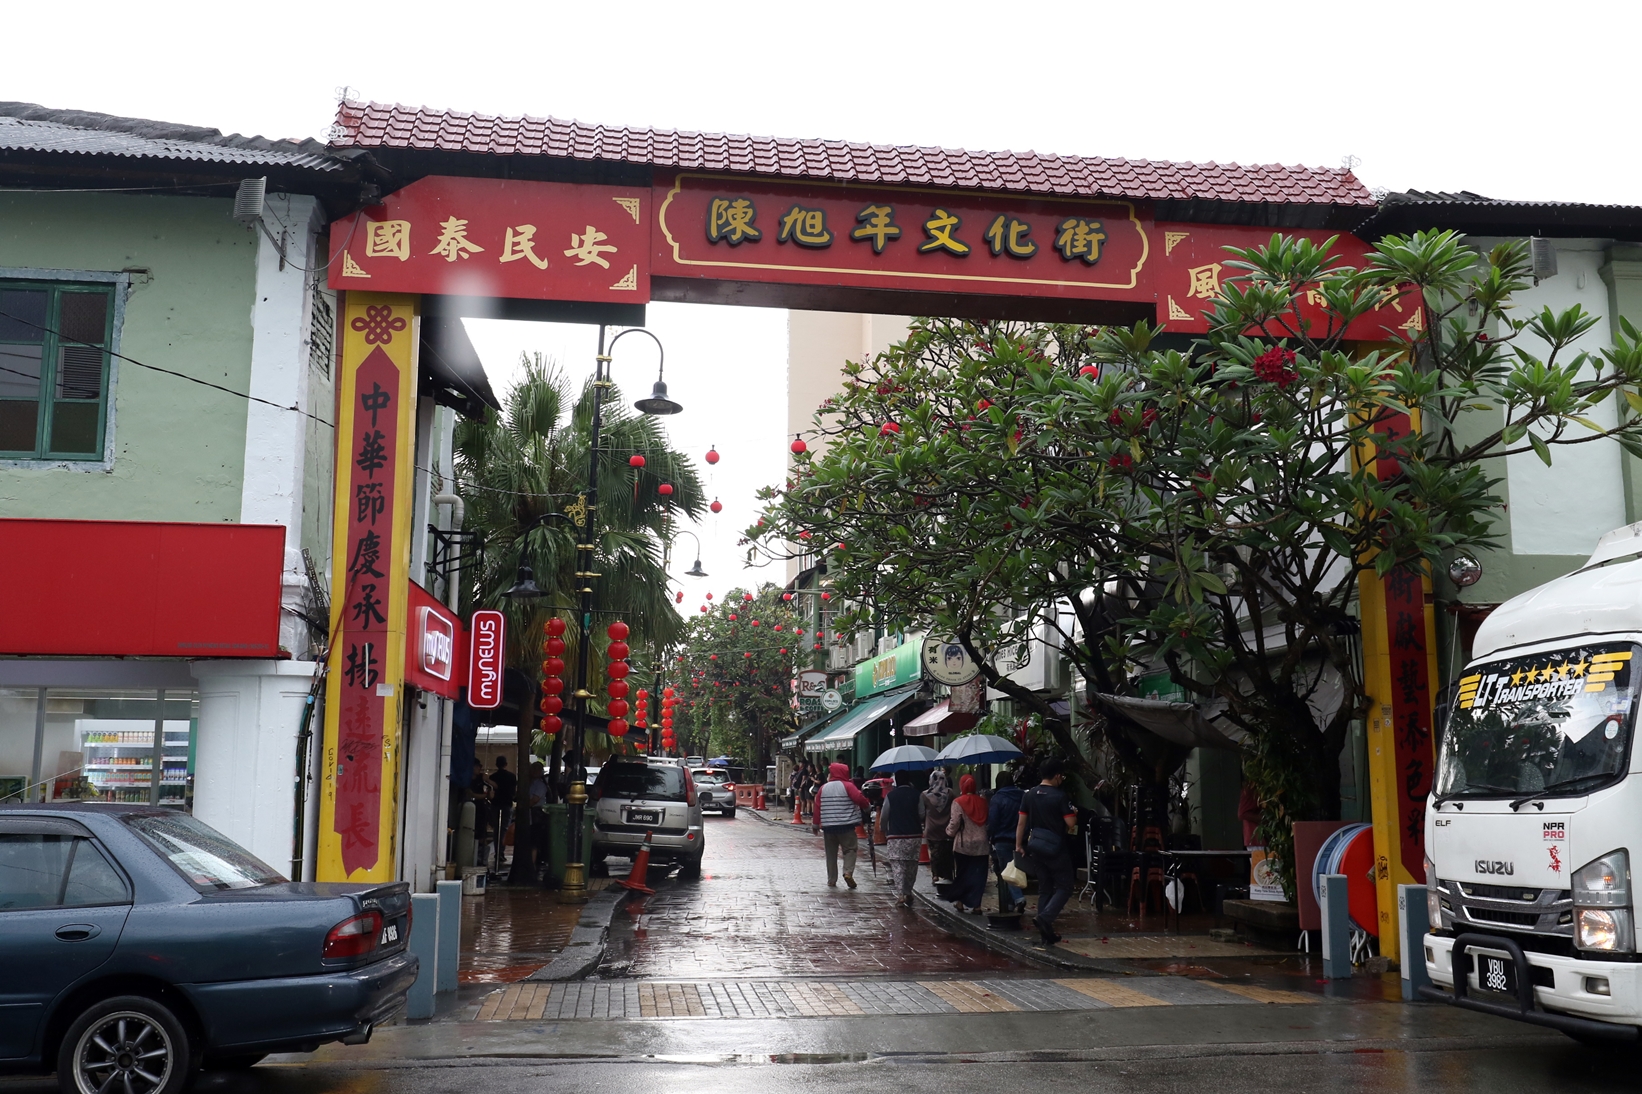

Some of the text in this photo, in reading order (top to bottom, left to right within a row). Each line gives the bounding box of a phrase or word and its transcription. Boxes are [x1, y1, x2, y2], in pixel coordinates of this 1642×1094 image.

[707, 197, 1107, 263] 陳旭年文化街
[365, 215, 618, 270] 國泰民安
[1493, 676, 1585, 705] TRANSPORTER
[1435, 819, 1451, 827] ELF
[1543, 822, 1565, 831] NPR
[1543, 831, 1565, 839] PRO
[1475, 859, 1514, 876] ISUZU
[1487, 958, 1504, 976] VBU
[1486, 972, 1507, 990] 3982
